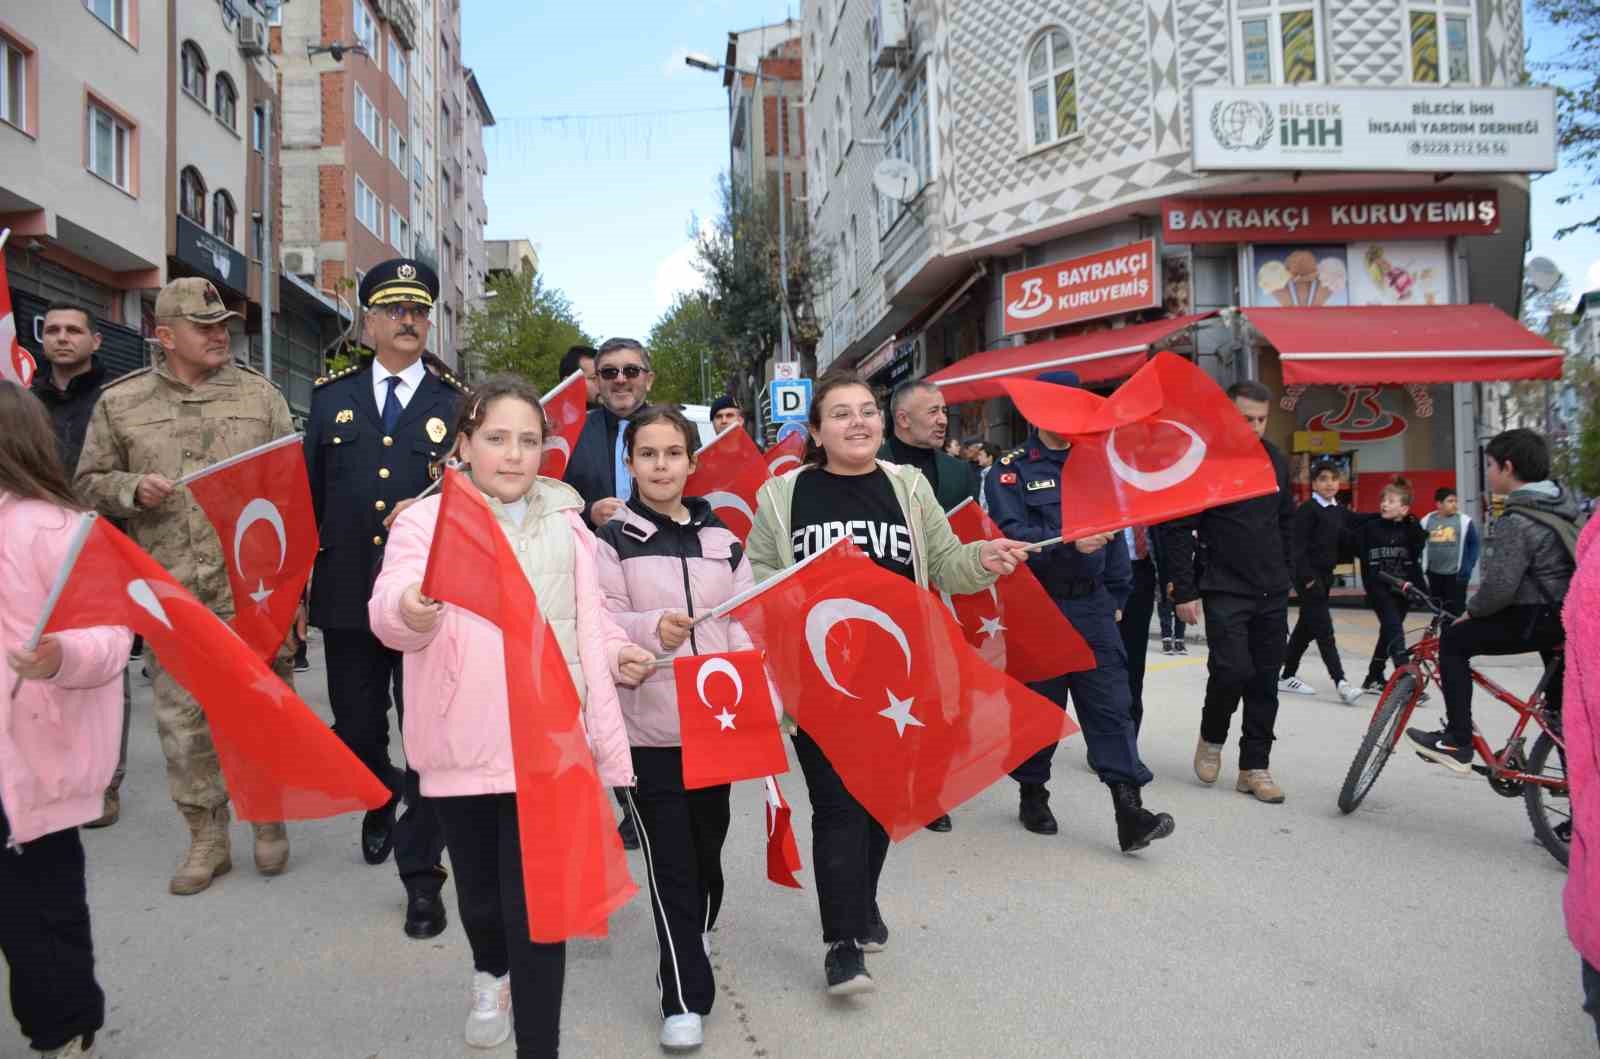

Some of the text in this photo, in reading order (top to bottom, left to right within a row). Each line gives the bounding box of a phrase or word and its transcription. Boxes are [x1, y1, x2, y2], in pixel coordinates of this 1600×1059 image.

[1280, 100, 1340, 116] BİLECİK
[1421, 121, 1475, 134] YARDIM
[1168, 207, 1310, 231] BAYRAKÇI
[1057, 252, 1148, 288] BAYRAKÇI
[1058, 278, 1149, 310] KURUYEMİŞ
[783, 391, 801, 411] D
[791, 520, 913, 565] FOREVE
